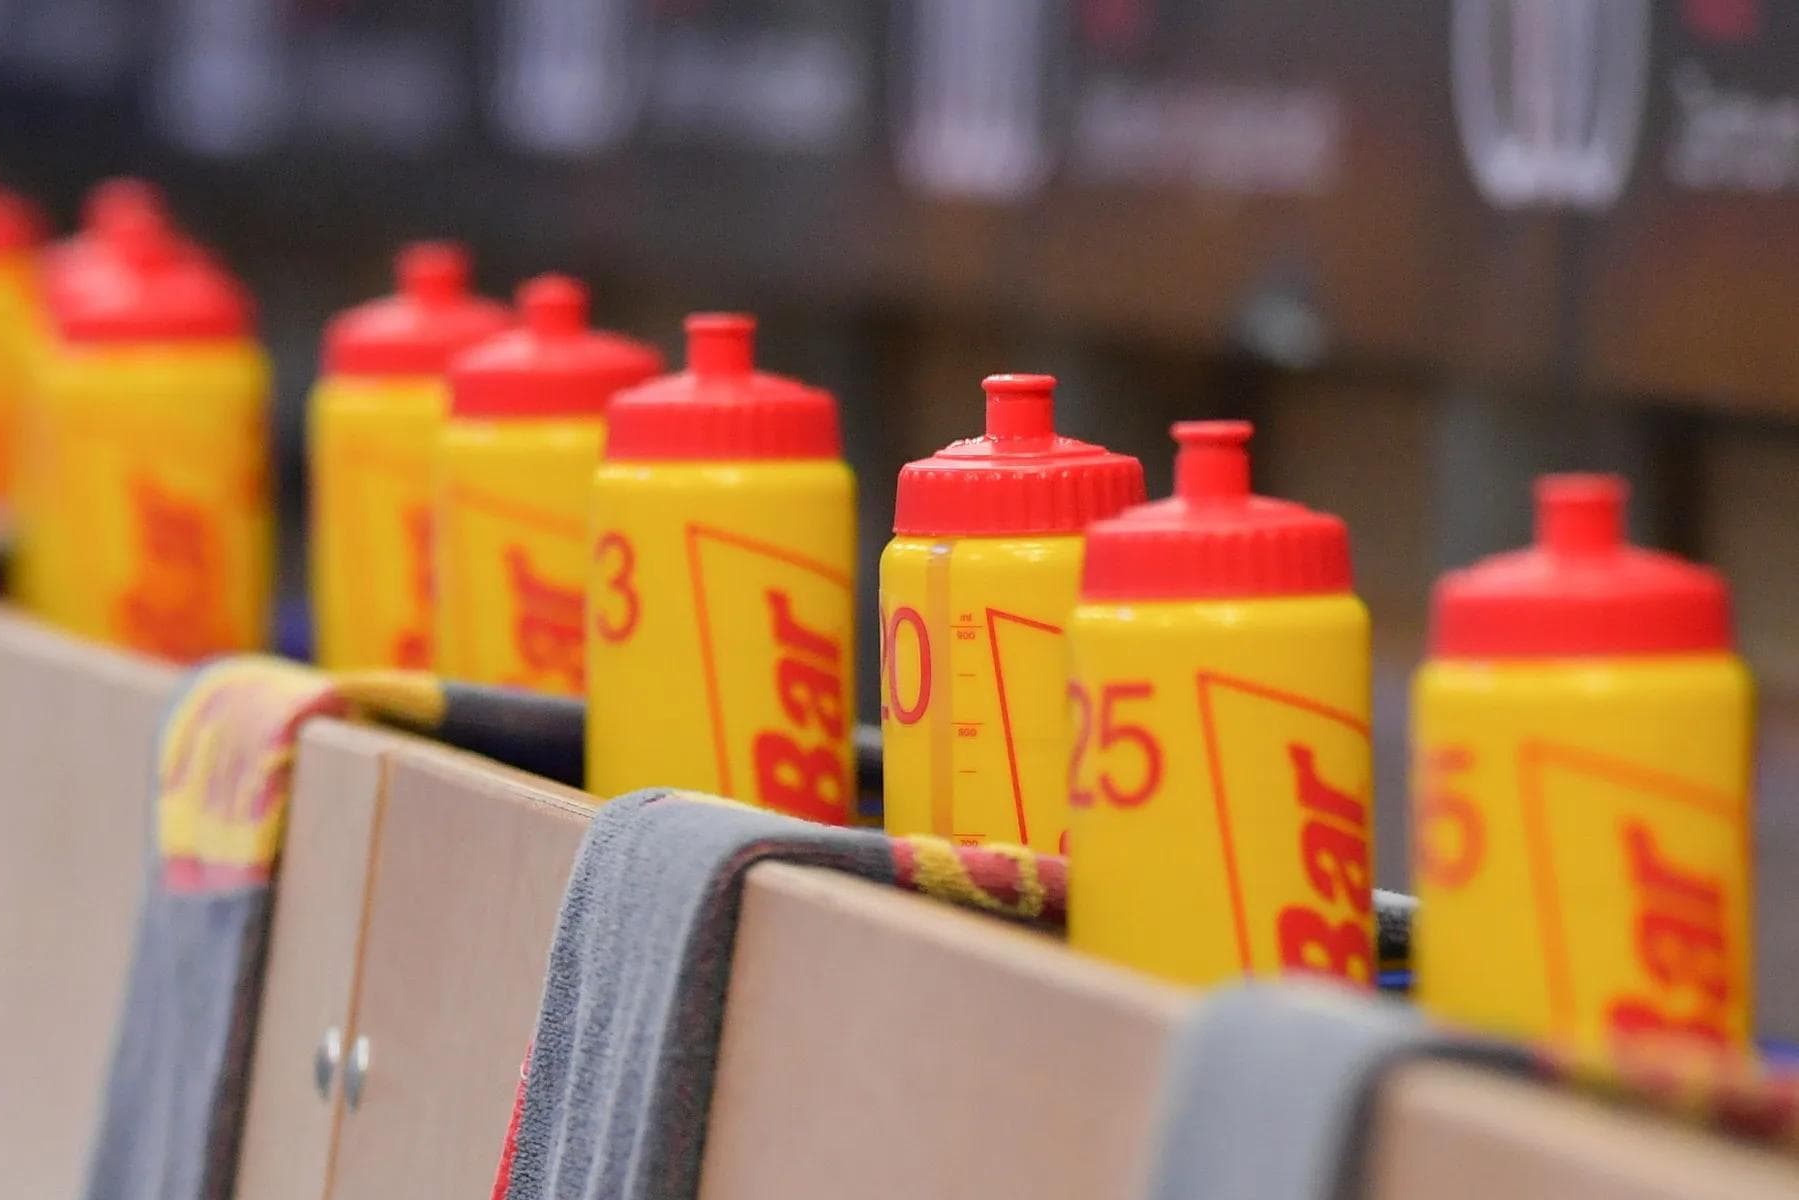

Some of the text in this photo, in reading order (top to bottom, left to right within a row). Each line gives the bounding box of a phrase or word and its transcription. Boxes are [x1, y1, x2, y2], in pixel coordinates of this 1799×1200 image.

[754, 585, 846, 827] Bar
[880, 606, 932, 724] 0
[1066, 678, 1165, 811] 25
[1277, 740, 1373, 990] Bar
